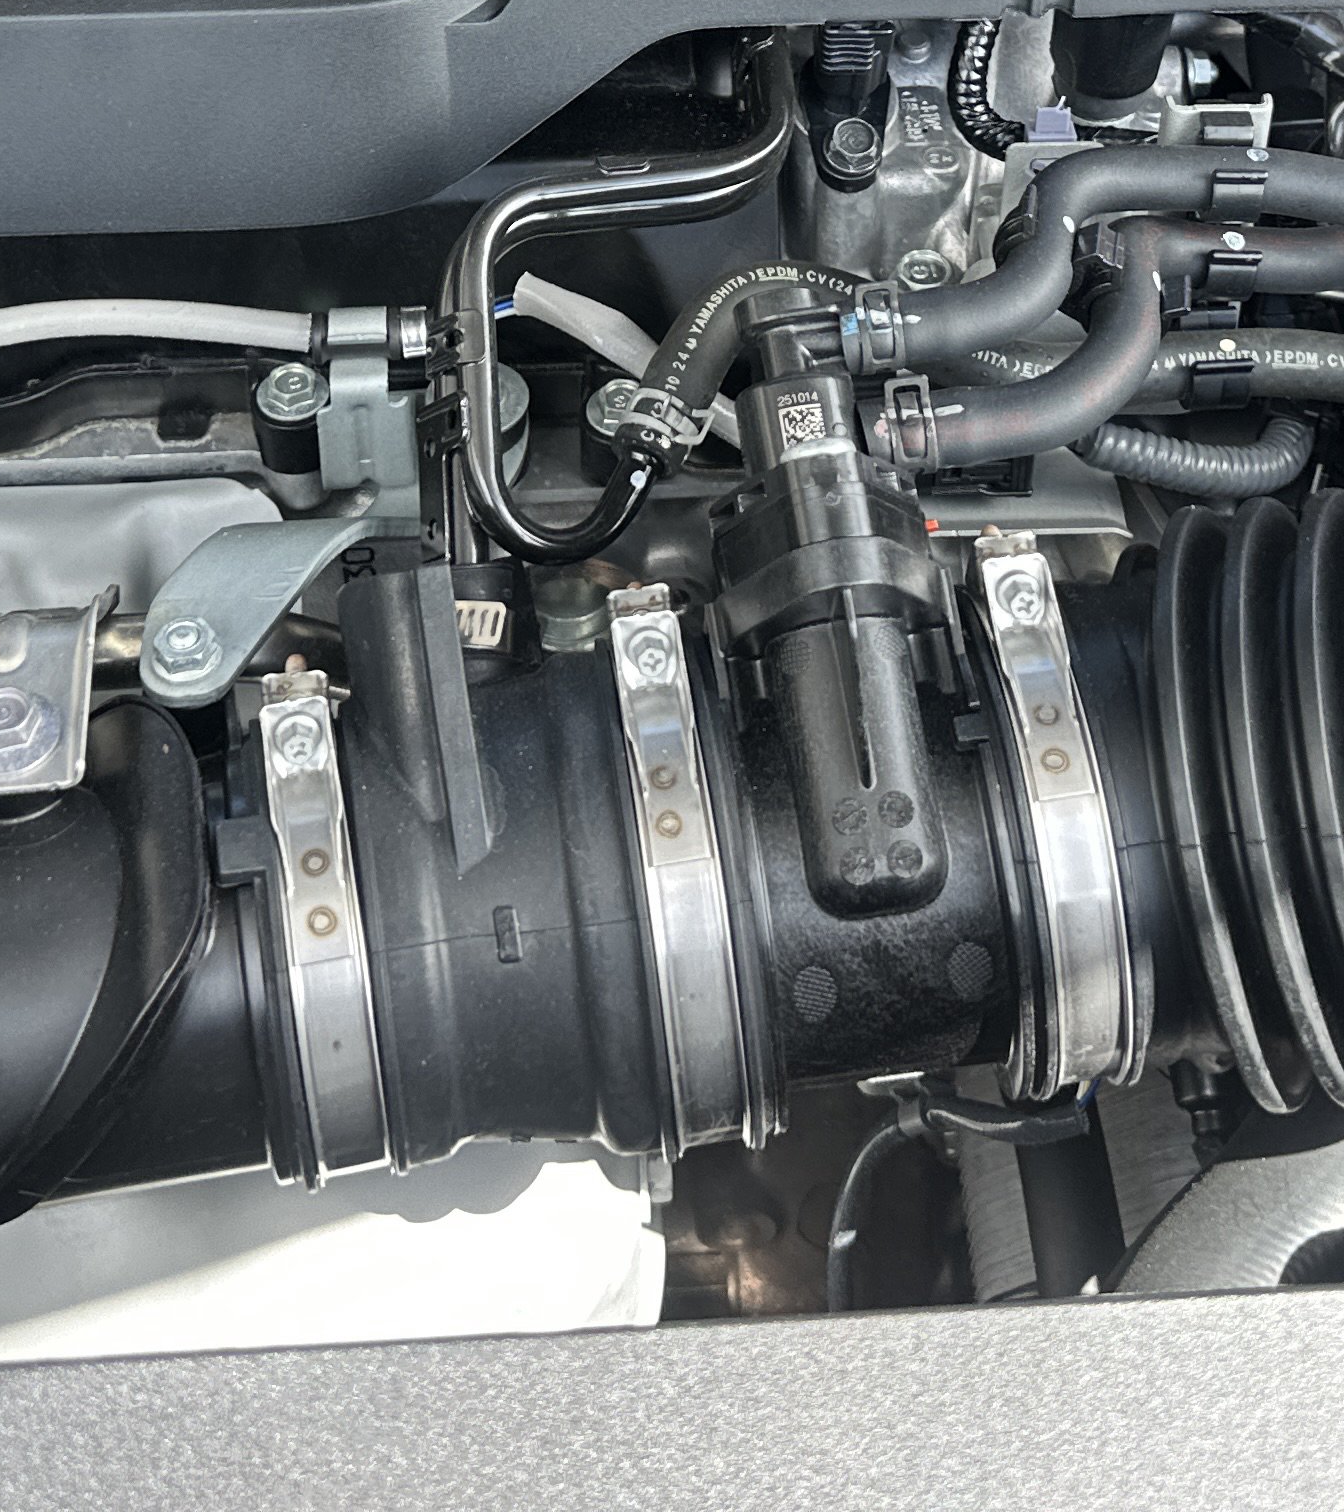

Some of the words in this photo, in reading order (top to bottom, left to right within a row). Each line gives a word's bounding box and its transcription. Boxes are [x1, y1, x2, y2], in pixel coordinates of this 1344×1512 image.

[672, 351, 690, 371] 24
[689, 275, 748, 334] YAMASHITA
[777, 391, 819, 407] 251014
